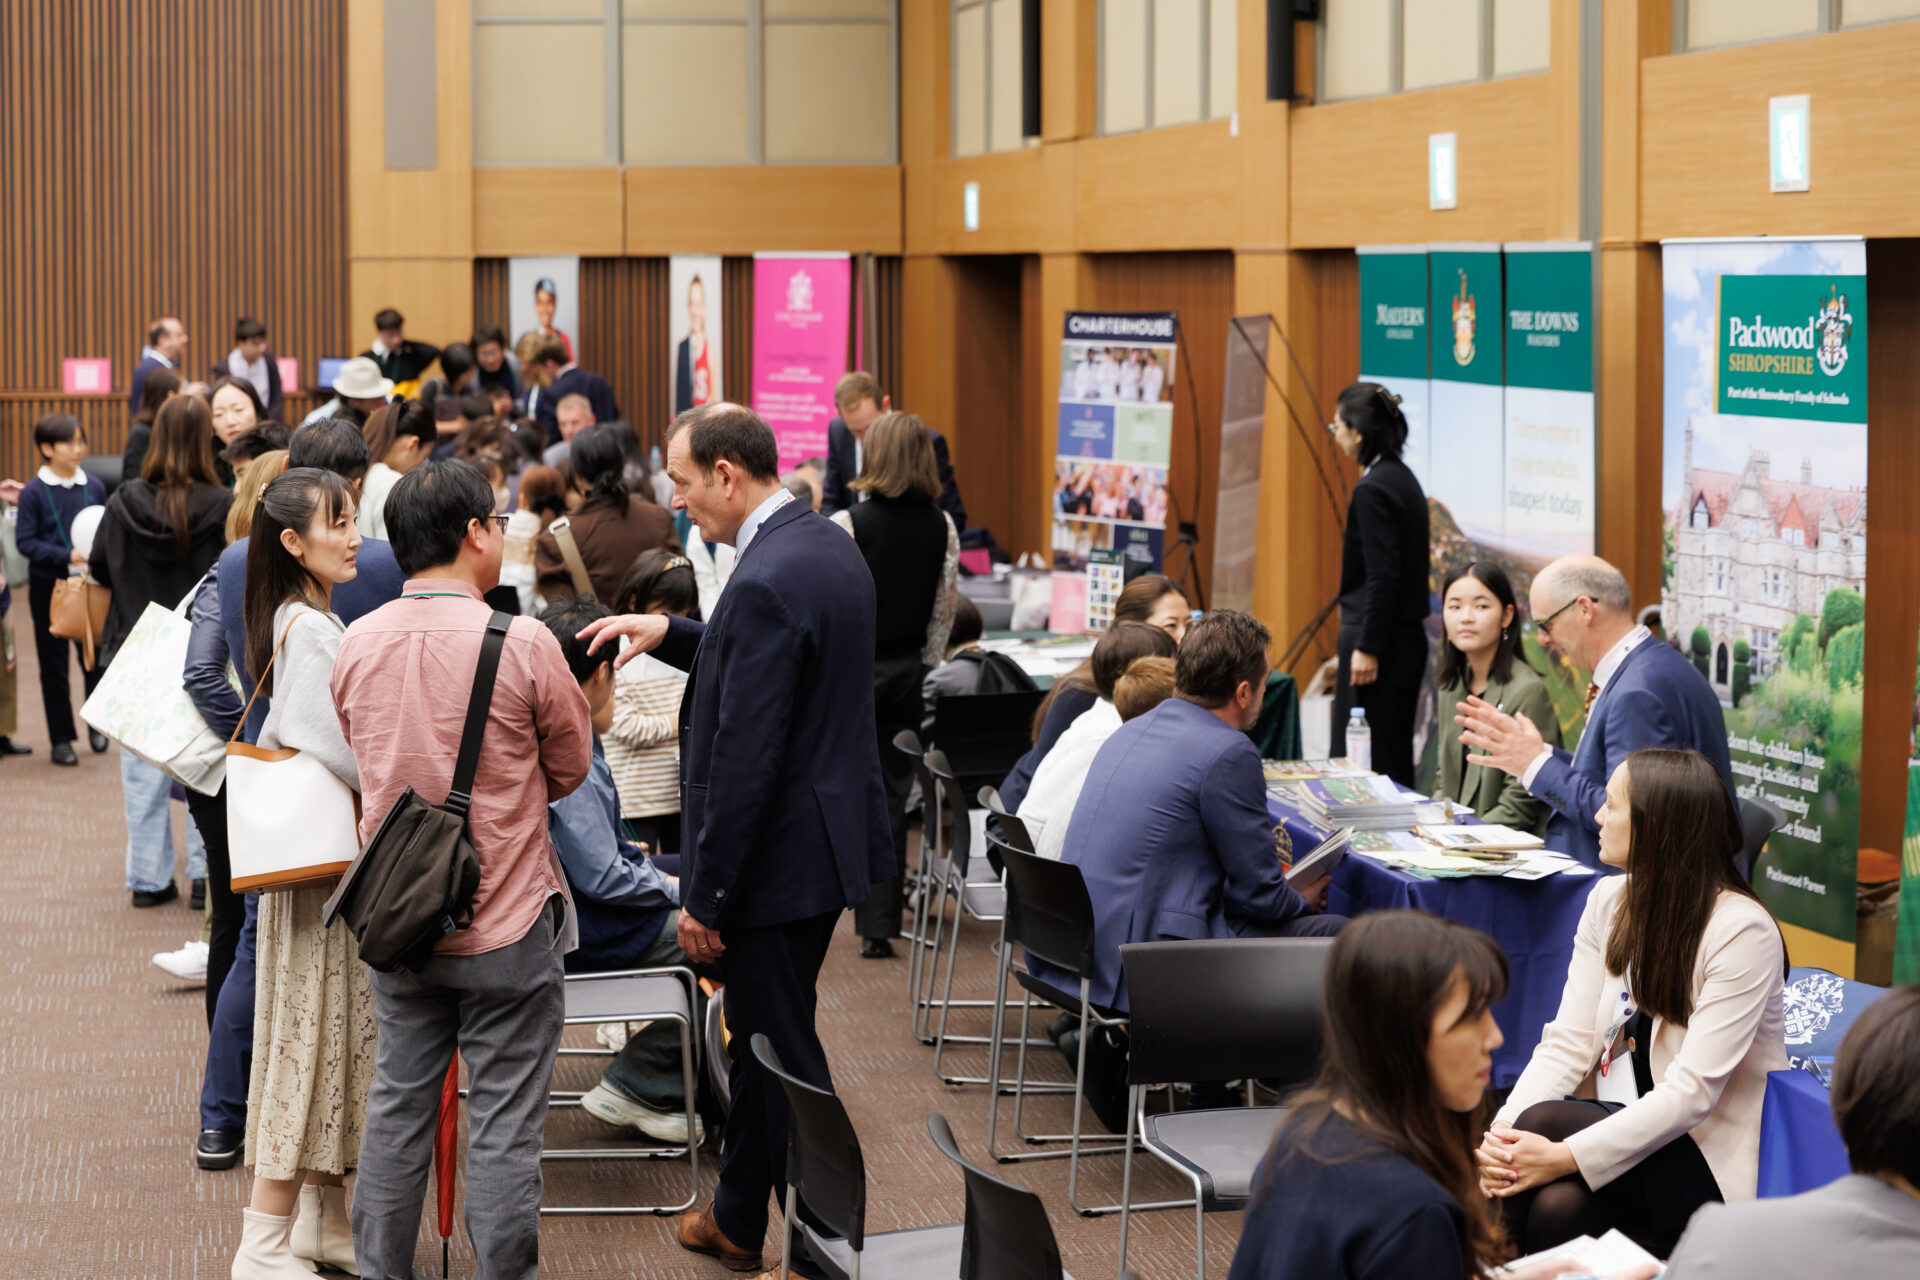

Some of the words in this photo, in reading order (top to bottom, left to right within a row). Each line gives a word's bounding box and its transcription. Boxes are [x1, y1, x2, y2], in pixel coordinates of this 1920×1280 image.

[1068, 315, 1173, 337] CHARTERHOUSE
[1509, 310, 1534, 330] THE
[1534, 310, 1579, 332] DOWNS
[1729, 315, 1814, 349] Packwood
[1728, 353, 1814, 375] SHROPSHIRE
[1507, 485, 1547, 516] shaped
[1749, 736, 1765, 755] the
[1764, 740, 1804, 765] children
[1762, 762, 1801, 788] facilities
[1800, 774, 1819, 793] and
[1793, 819, 1822, 843] found
